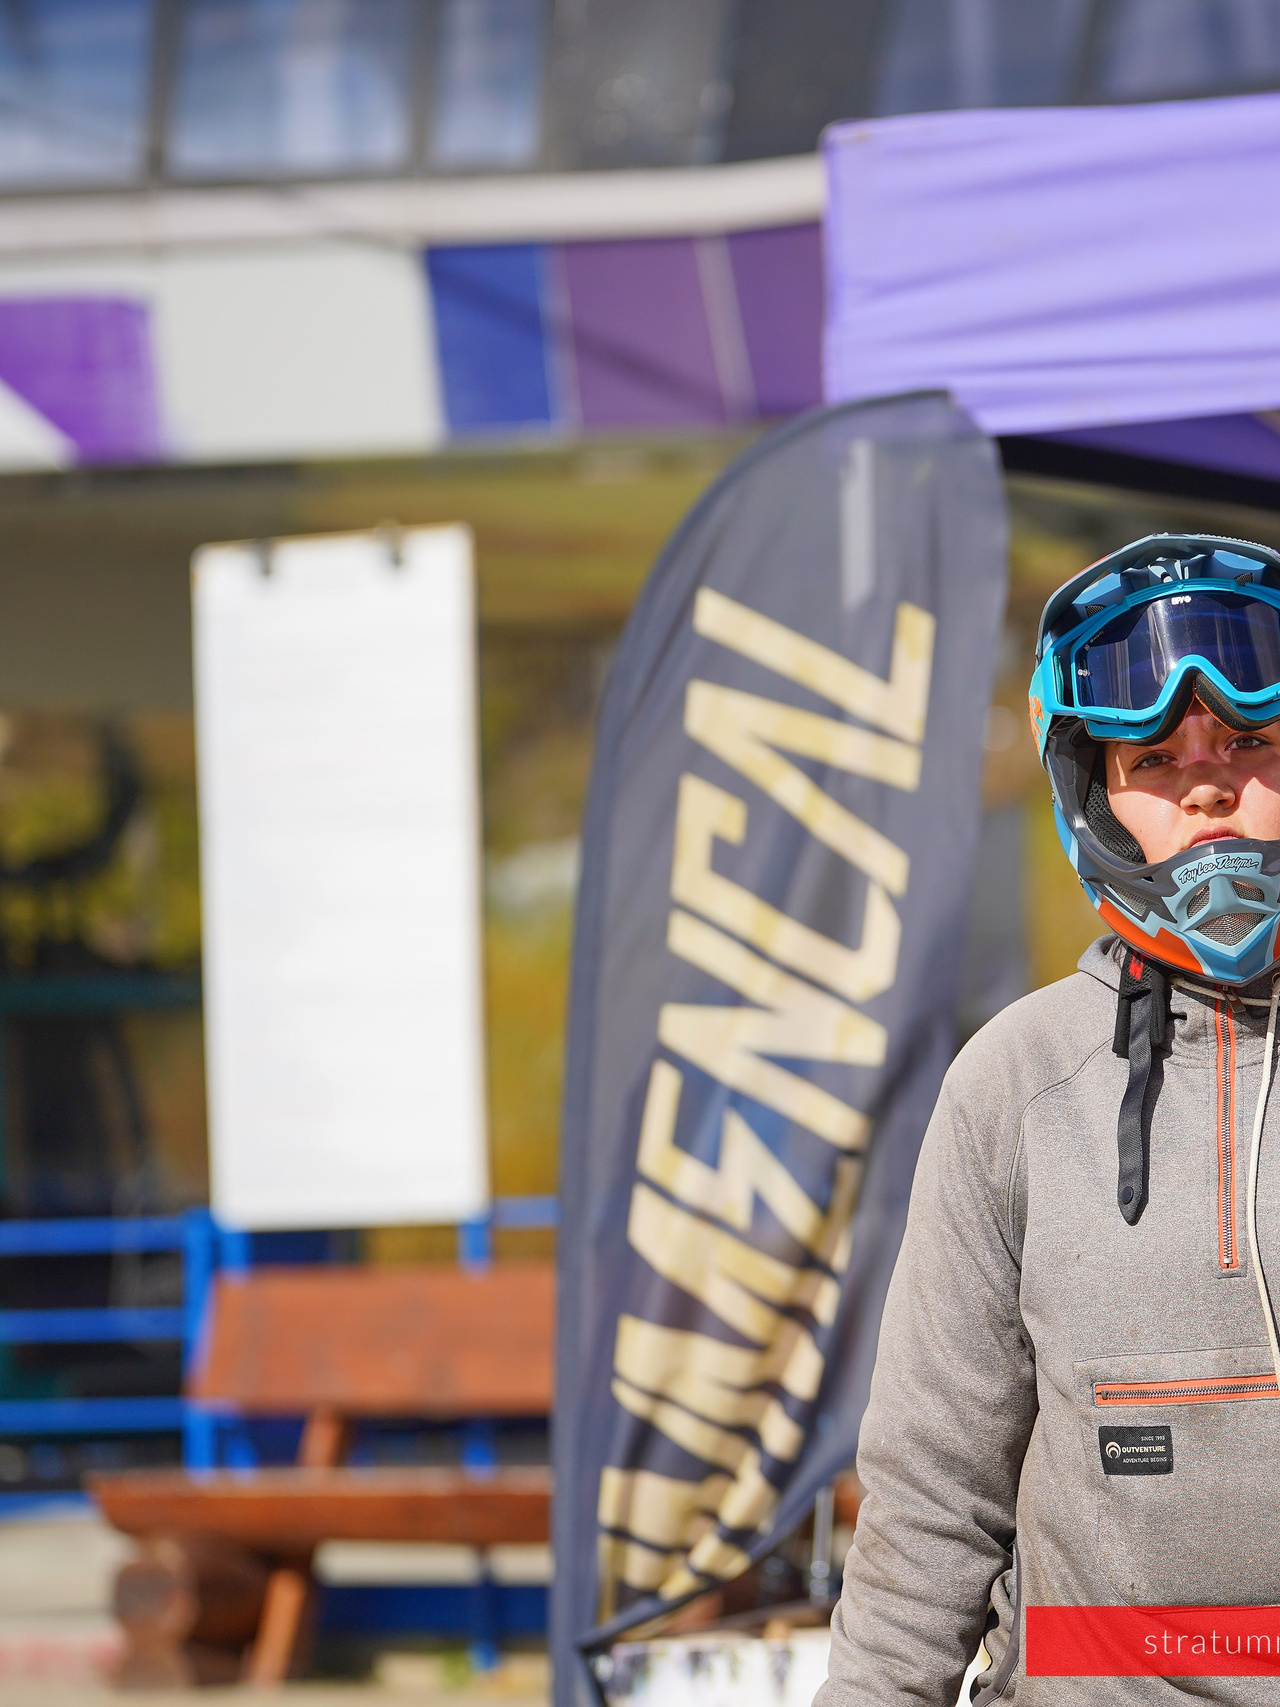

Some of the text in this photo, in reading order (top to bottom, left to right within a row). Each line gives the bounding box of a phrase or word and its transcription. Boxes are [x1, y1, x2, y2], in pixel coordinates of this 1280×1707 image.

[1178, 854, 1260, 885] Troy Lee Designs
[1121, 1445, 1166, 1454] OUTVENTURE
